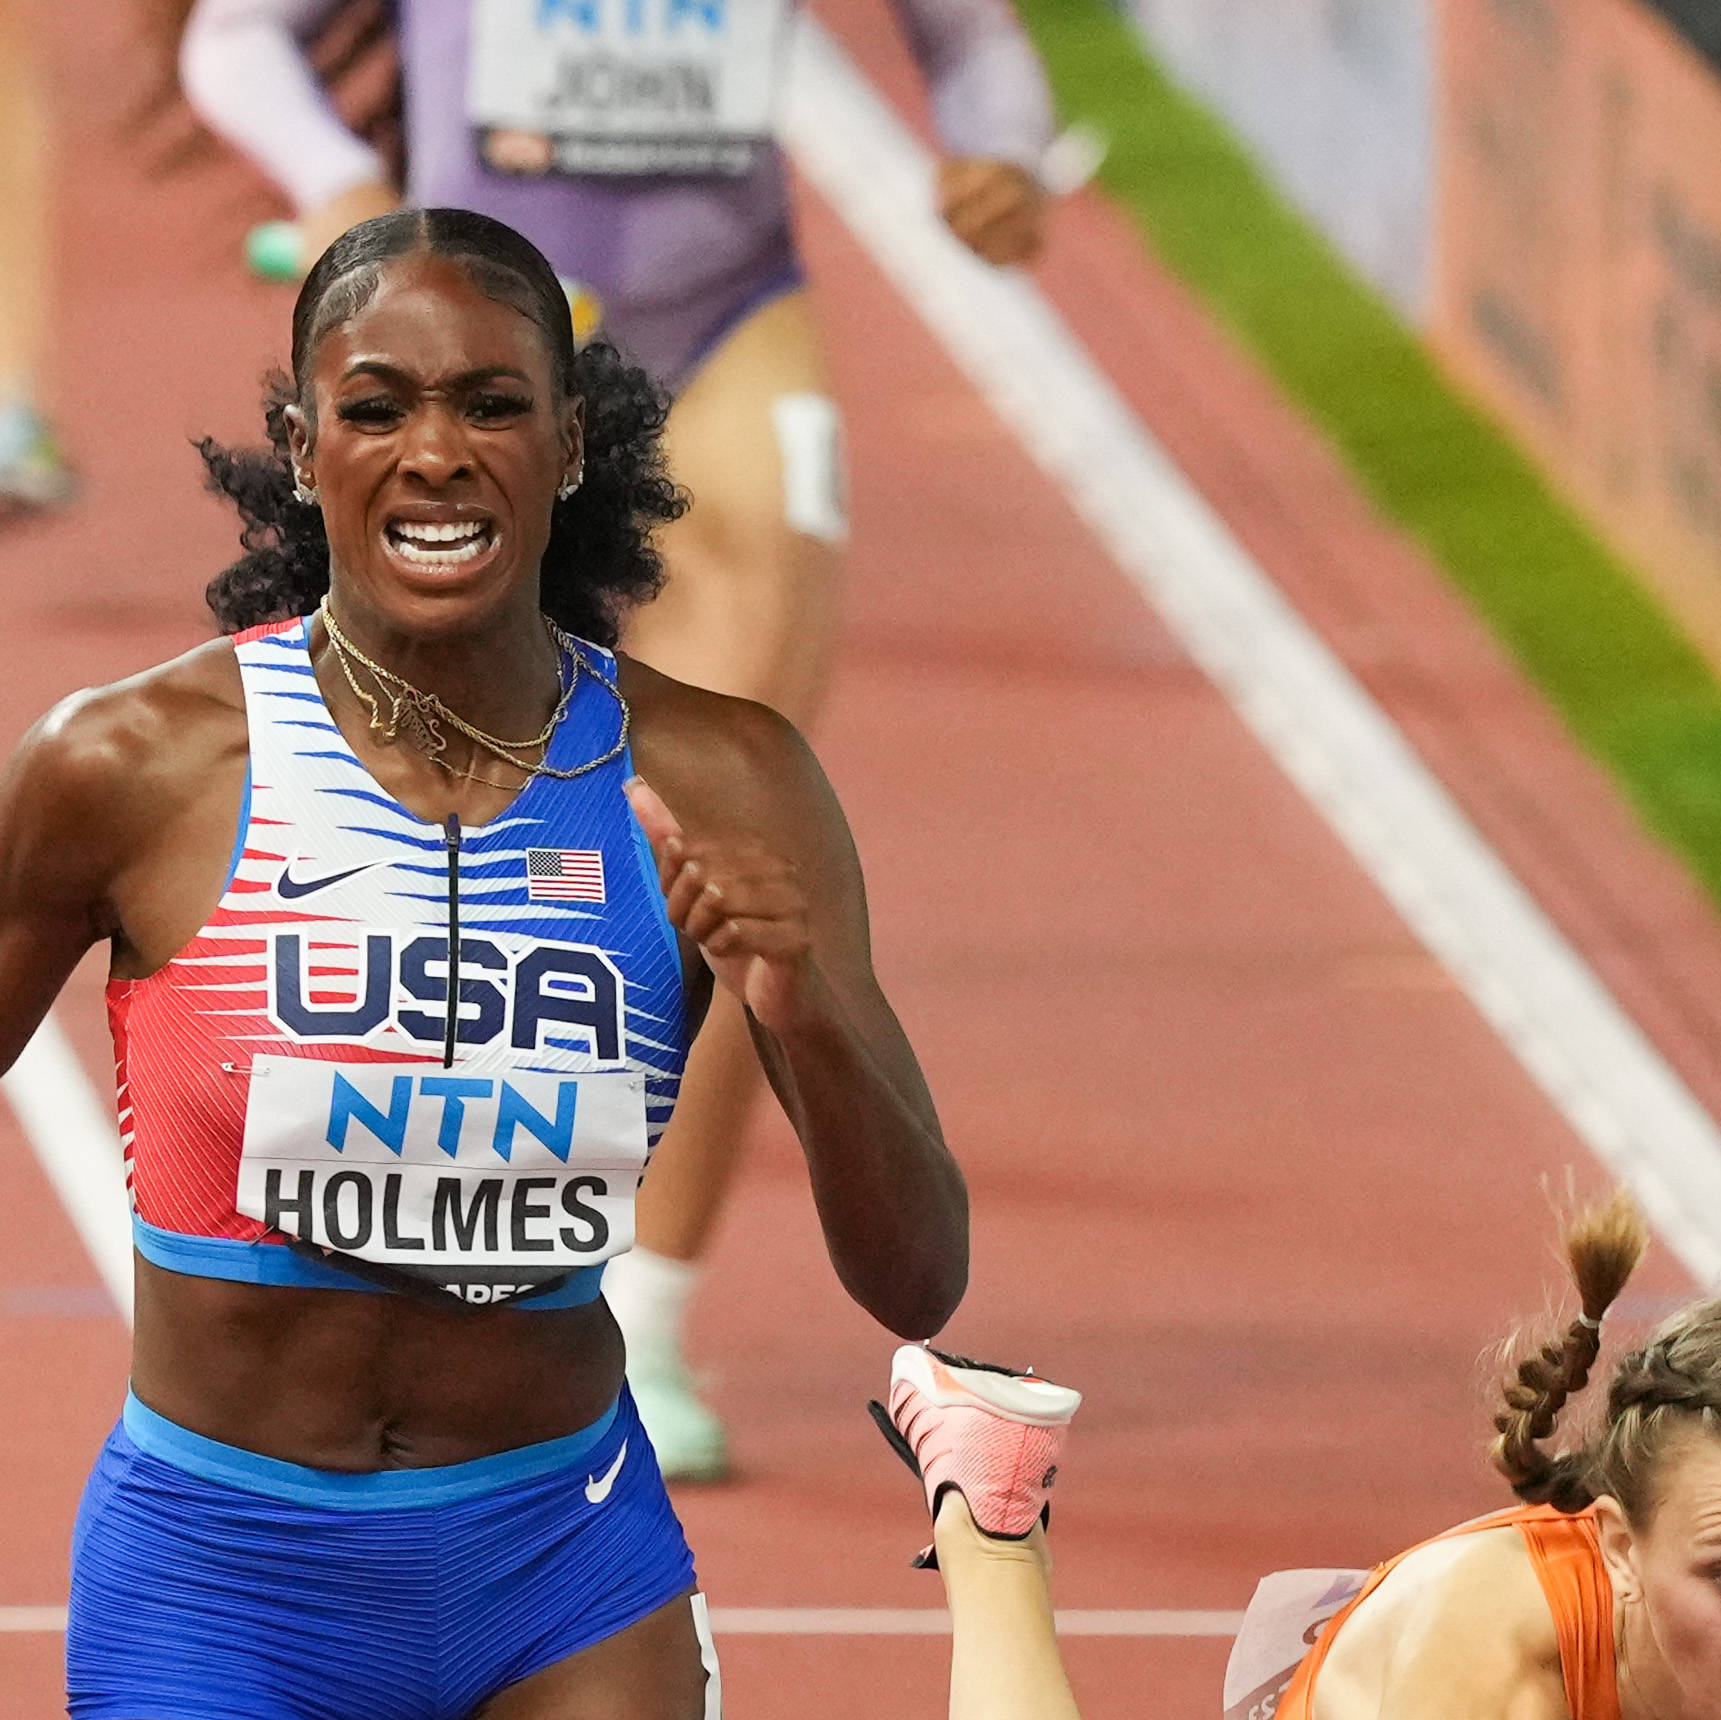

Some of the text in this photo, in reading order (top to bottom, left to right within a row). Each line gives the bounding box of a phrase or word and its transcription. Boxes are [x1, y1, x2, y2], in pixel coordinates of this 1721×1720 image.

[542, 50, 718, 111] JOHN
[270, 930, 625, 1064] USA
[325, 1070, 578, 1165] NTN
[264, 1168, 610, 1254] HOLMES
